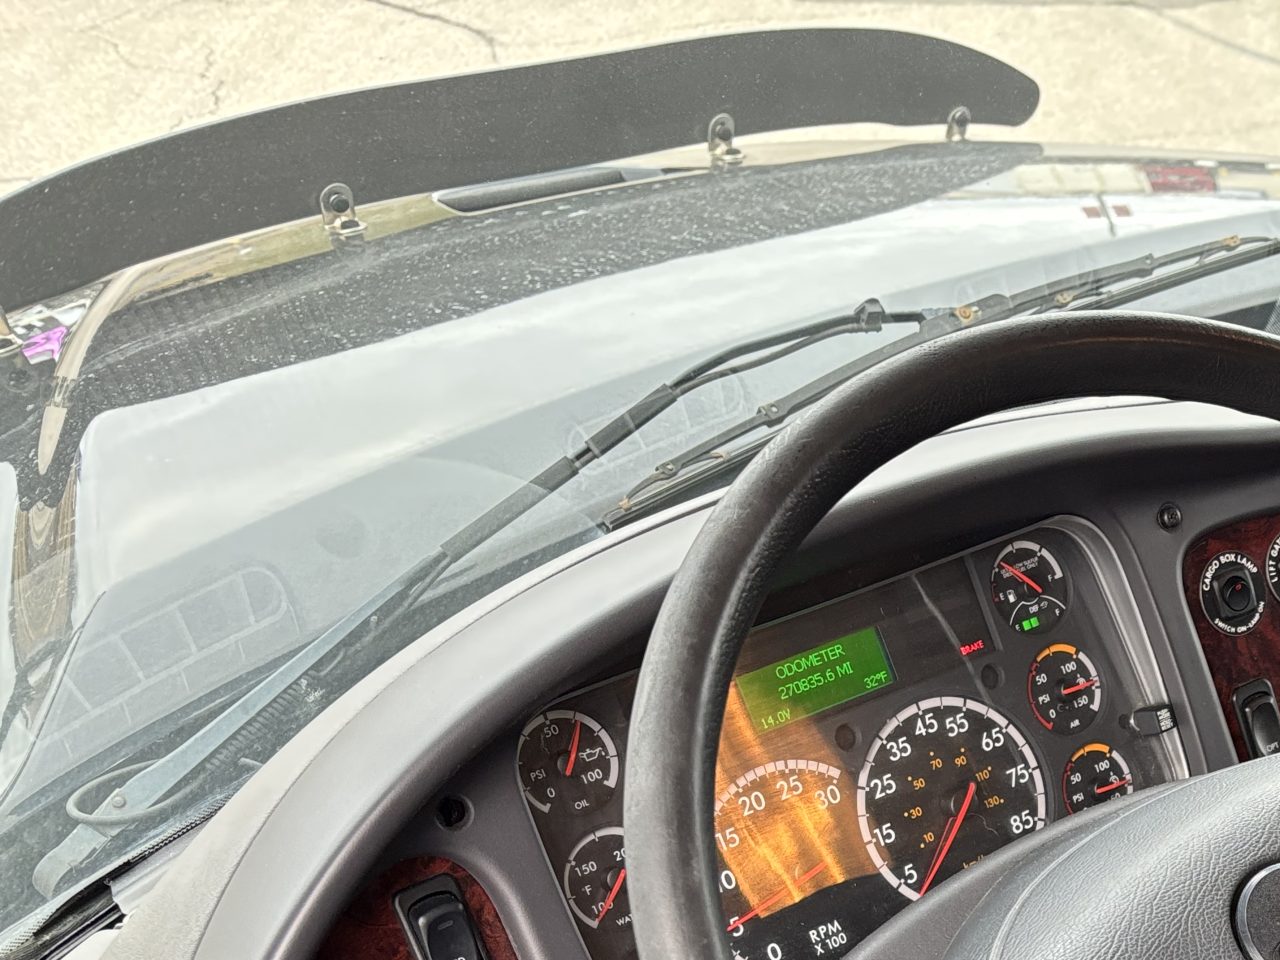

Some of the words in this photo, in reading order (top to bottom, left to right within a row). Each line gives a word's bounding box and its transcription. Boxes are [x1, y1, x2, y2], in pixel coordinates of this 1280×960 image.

[1203, 560, 1219, 591] CARGO
[1219, 553, 1236, 564] BOX
[1237, 555, 1258, 573] LAMP
[1268, 560, 1278, 583] LIFT
[960, 639, 985, 656] BRAKE
[775, 644, 845, 679] ODOMETER
[1060, 661, 1077, 675] 100
[778, 669, 835, 700] 270835.6
[837, 661, 854, 678] MI
[1035, 673, 1048, 685] 50
[1038, 694, 1050, 705] PSI
[1073, 695, 1089, 709] 150
[761, 708, 791, 729] 14.0V
[1049, 709, 1056, 719] 0
[543, 724, 559, 738] 50
[915, 713, 938, 736] 45
[945, 713, 969, 737] 55
[1070, 719, 1080, 729] AIR
[981, 728, 1004, 752] 65
[886, 736, 912, 761] 35
[930, 758, 943, 770] 70
[955, 756, 967, 767] 90
[1094, 760, 1110, 773] 100
[530, 769, 546, 781] PSI
[581, 768, 603, 784] 100
[976, 770, 990, 782] 110
[1005, 764, 1029, 788] 75
[1070, 773, 1082, 785] 50
[776, 775, 803, 801] 25
[870, 774, 897, 800] 25
[913, 777, 926, 791] 50
[546, 787, 556, 798] 0
[814, 785, 841, 810] 30
[1072, 792, 1084, 803] PSI
[574, 799, 590, 810] OIL
[738, 791, 766, 817] 20
[984, 796, 1000, 809] 130
[909, 807, 922, 819] 30
[1010, 810, 1034, 834] 85
[715, 827, 740, 851] 15
[873, 823, 896, 847] 15
[923, 832, 934, 843] 10
[575, 861, 597, 877] 150
[904, 863, 918, 884] 5
[809, 919, 842, 943] RPM
[814, 944, 824, 956] X
[826, 932, 847, 950] 100
